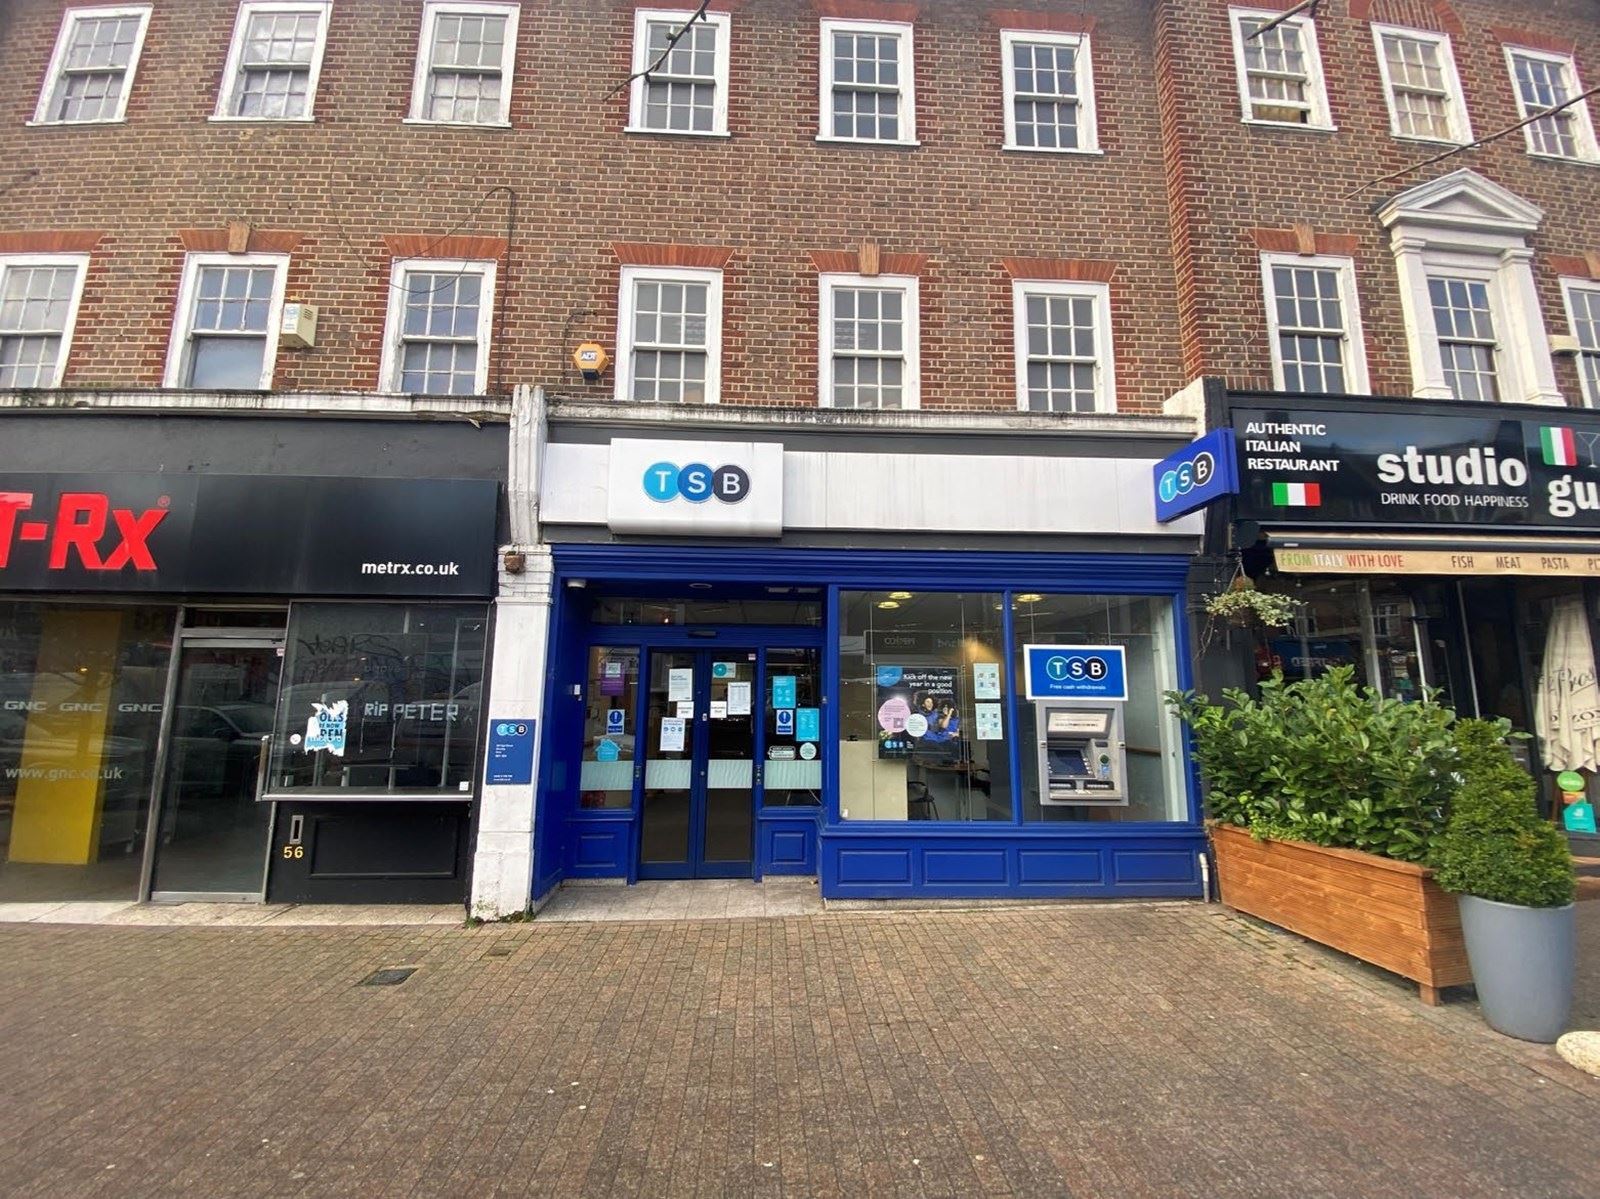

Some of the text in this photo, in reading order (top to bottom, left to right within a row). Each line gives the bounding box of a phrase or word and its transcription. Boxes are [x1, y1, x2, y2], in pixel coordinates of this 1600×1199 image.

[1245, 422, 1327, 436] AUTHENTIC
[1245, 440, 1301, 453] ITALIAN
[1247, 458, 1340, 472] RESTAURANT
[1376, 445, 1528, 487] studio
[652, 468, 743, 497] TSB
[1164, 459, 1209, 495] TSB
[1381, 492, 1529, 508] DRINK FOOD HAPPINESS
[1547, 474, 1600, 518] gu
[1280, 553, 1405, 568] FROM ITALY WITH LOVE
[1451, 555, 1474, 569] FISH
[1496, 556, 1521, 569] MEAT
[1541, 557, 1570, 570] PASTA
[361, 561, 460, 576] metrx.co.uk
[1051, 660, 1104, 678] TSB
[903, 673, 917, 681] Kick
[917, 673, 927, 681] off
[936, 681, 953, 689] good
[4, 701, 163, 713] GNC GNC GNC
[500, 725, 526, 735] TSB
[283, 845, 304, 859] 56
